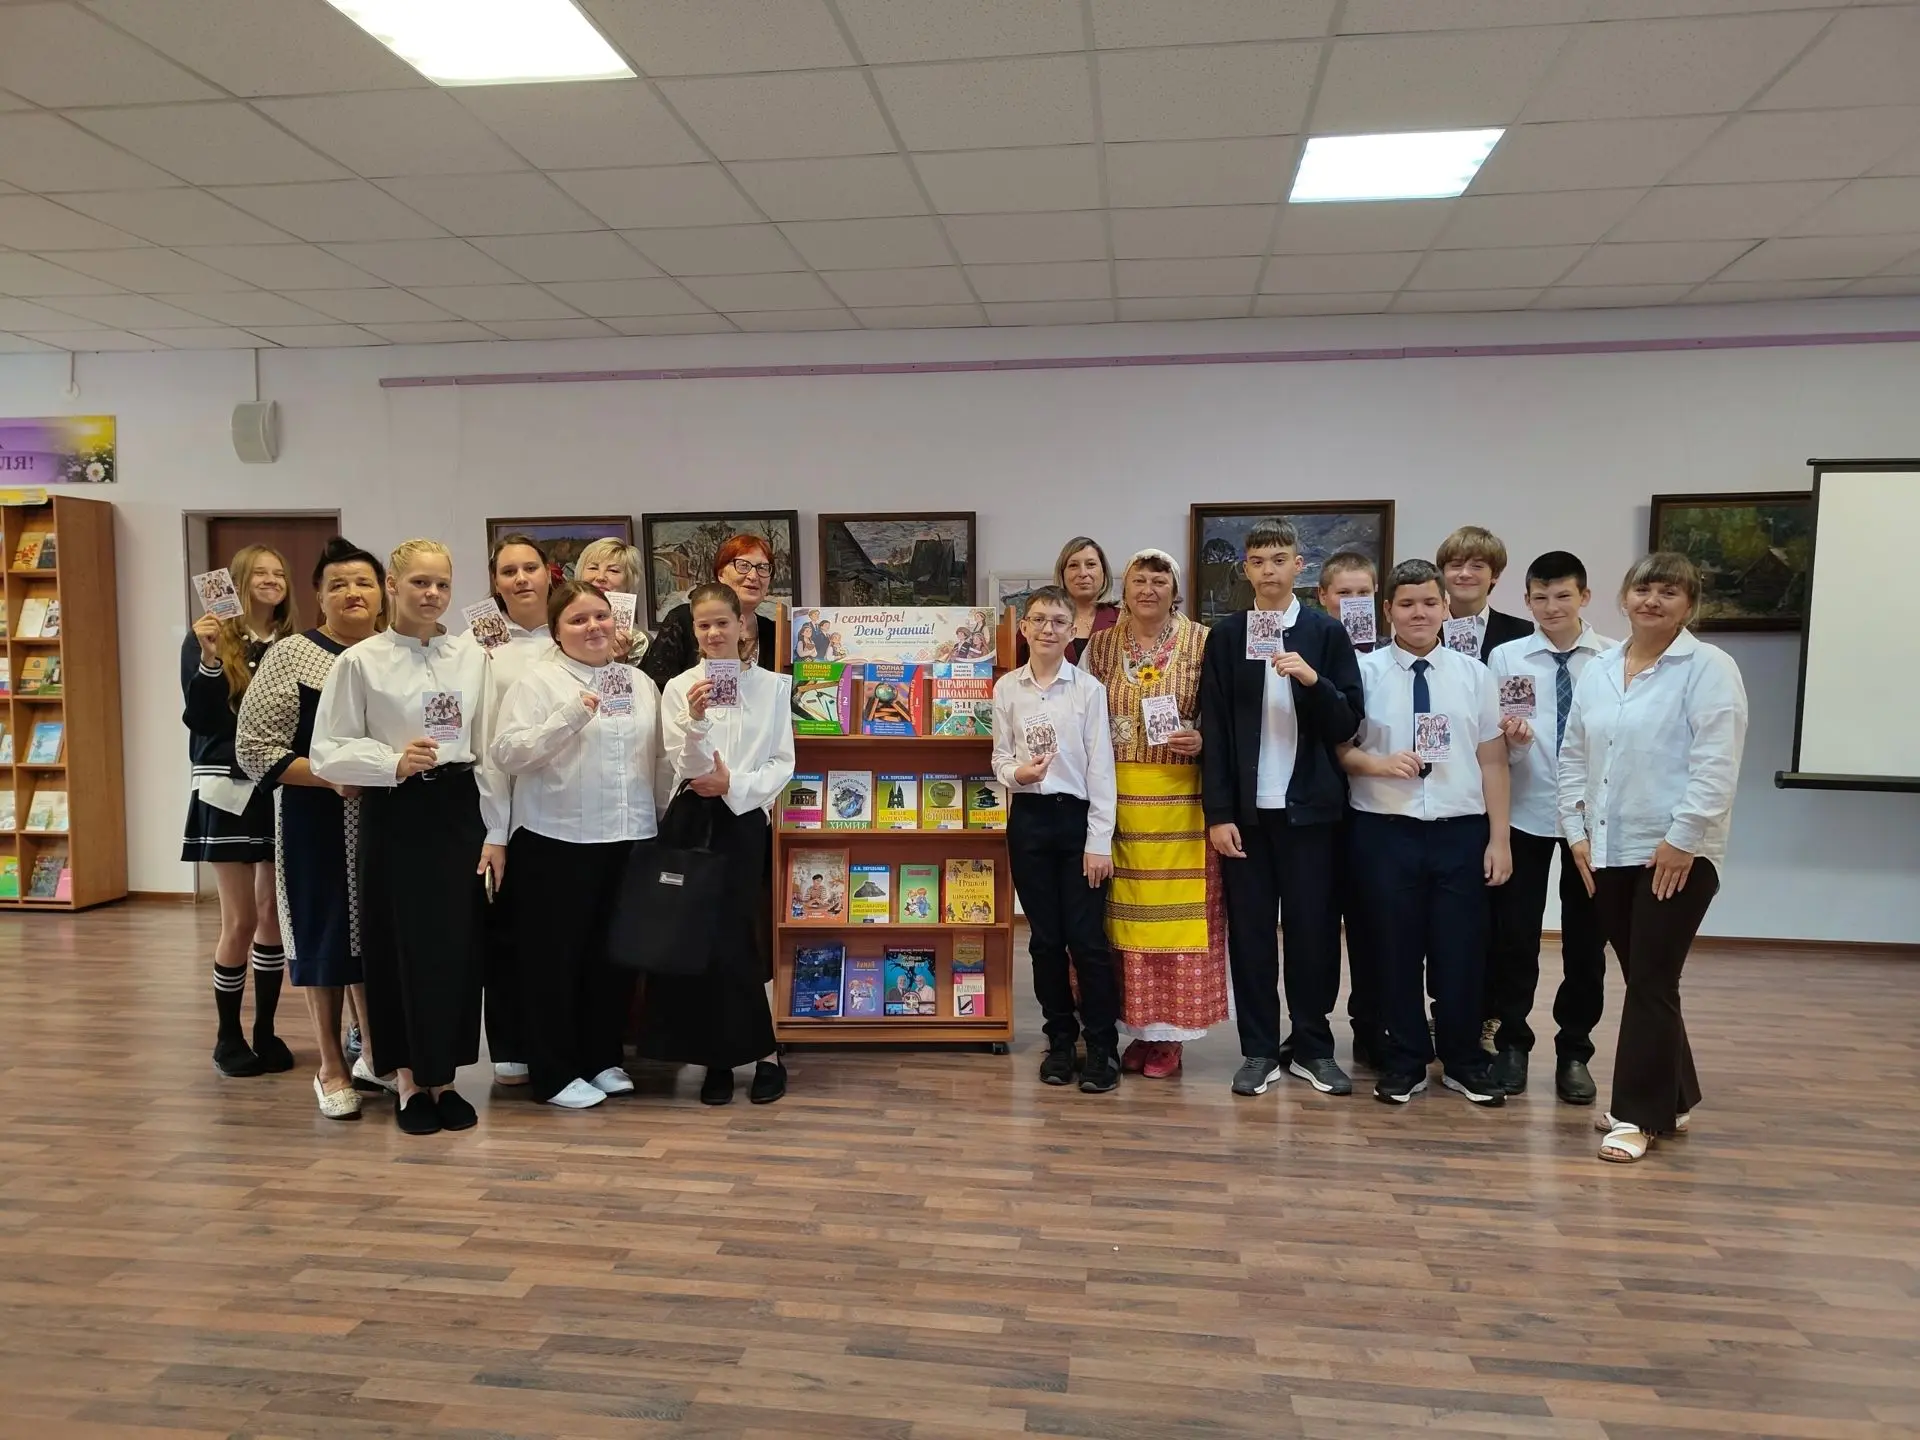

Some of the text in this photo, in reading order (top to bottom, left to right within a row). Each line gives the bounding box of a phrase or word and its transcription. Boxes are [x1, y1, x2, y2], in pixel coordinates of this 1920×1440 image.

[834, 611, 905, 628] 1 сентября!
[854, 623, 935, 640] День знаний!
[937, 680, 988, 688] СПРАВОЧНИК
[937, 689, 989, 698] ШКОЛЬНИКА
